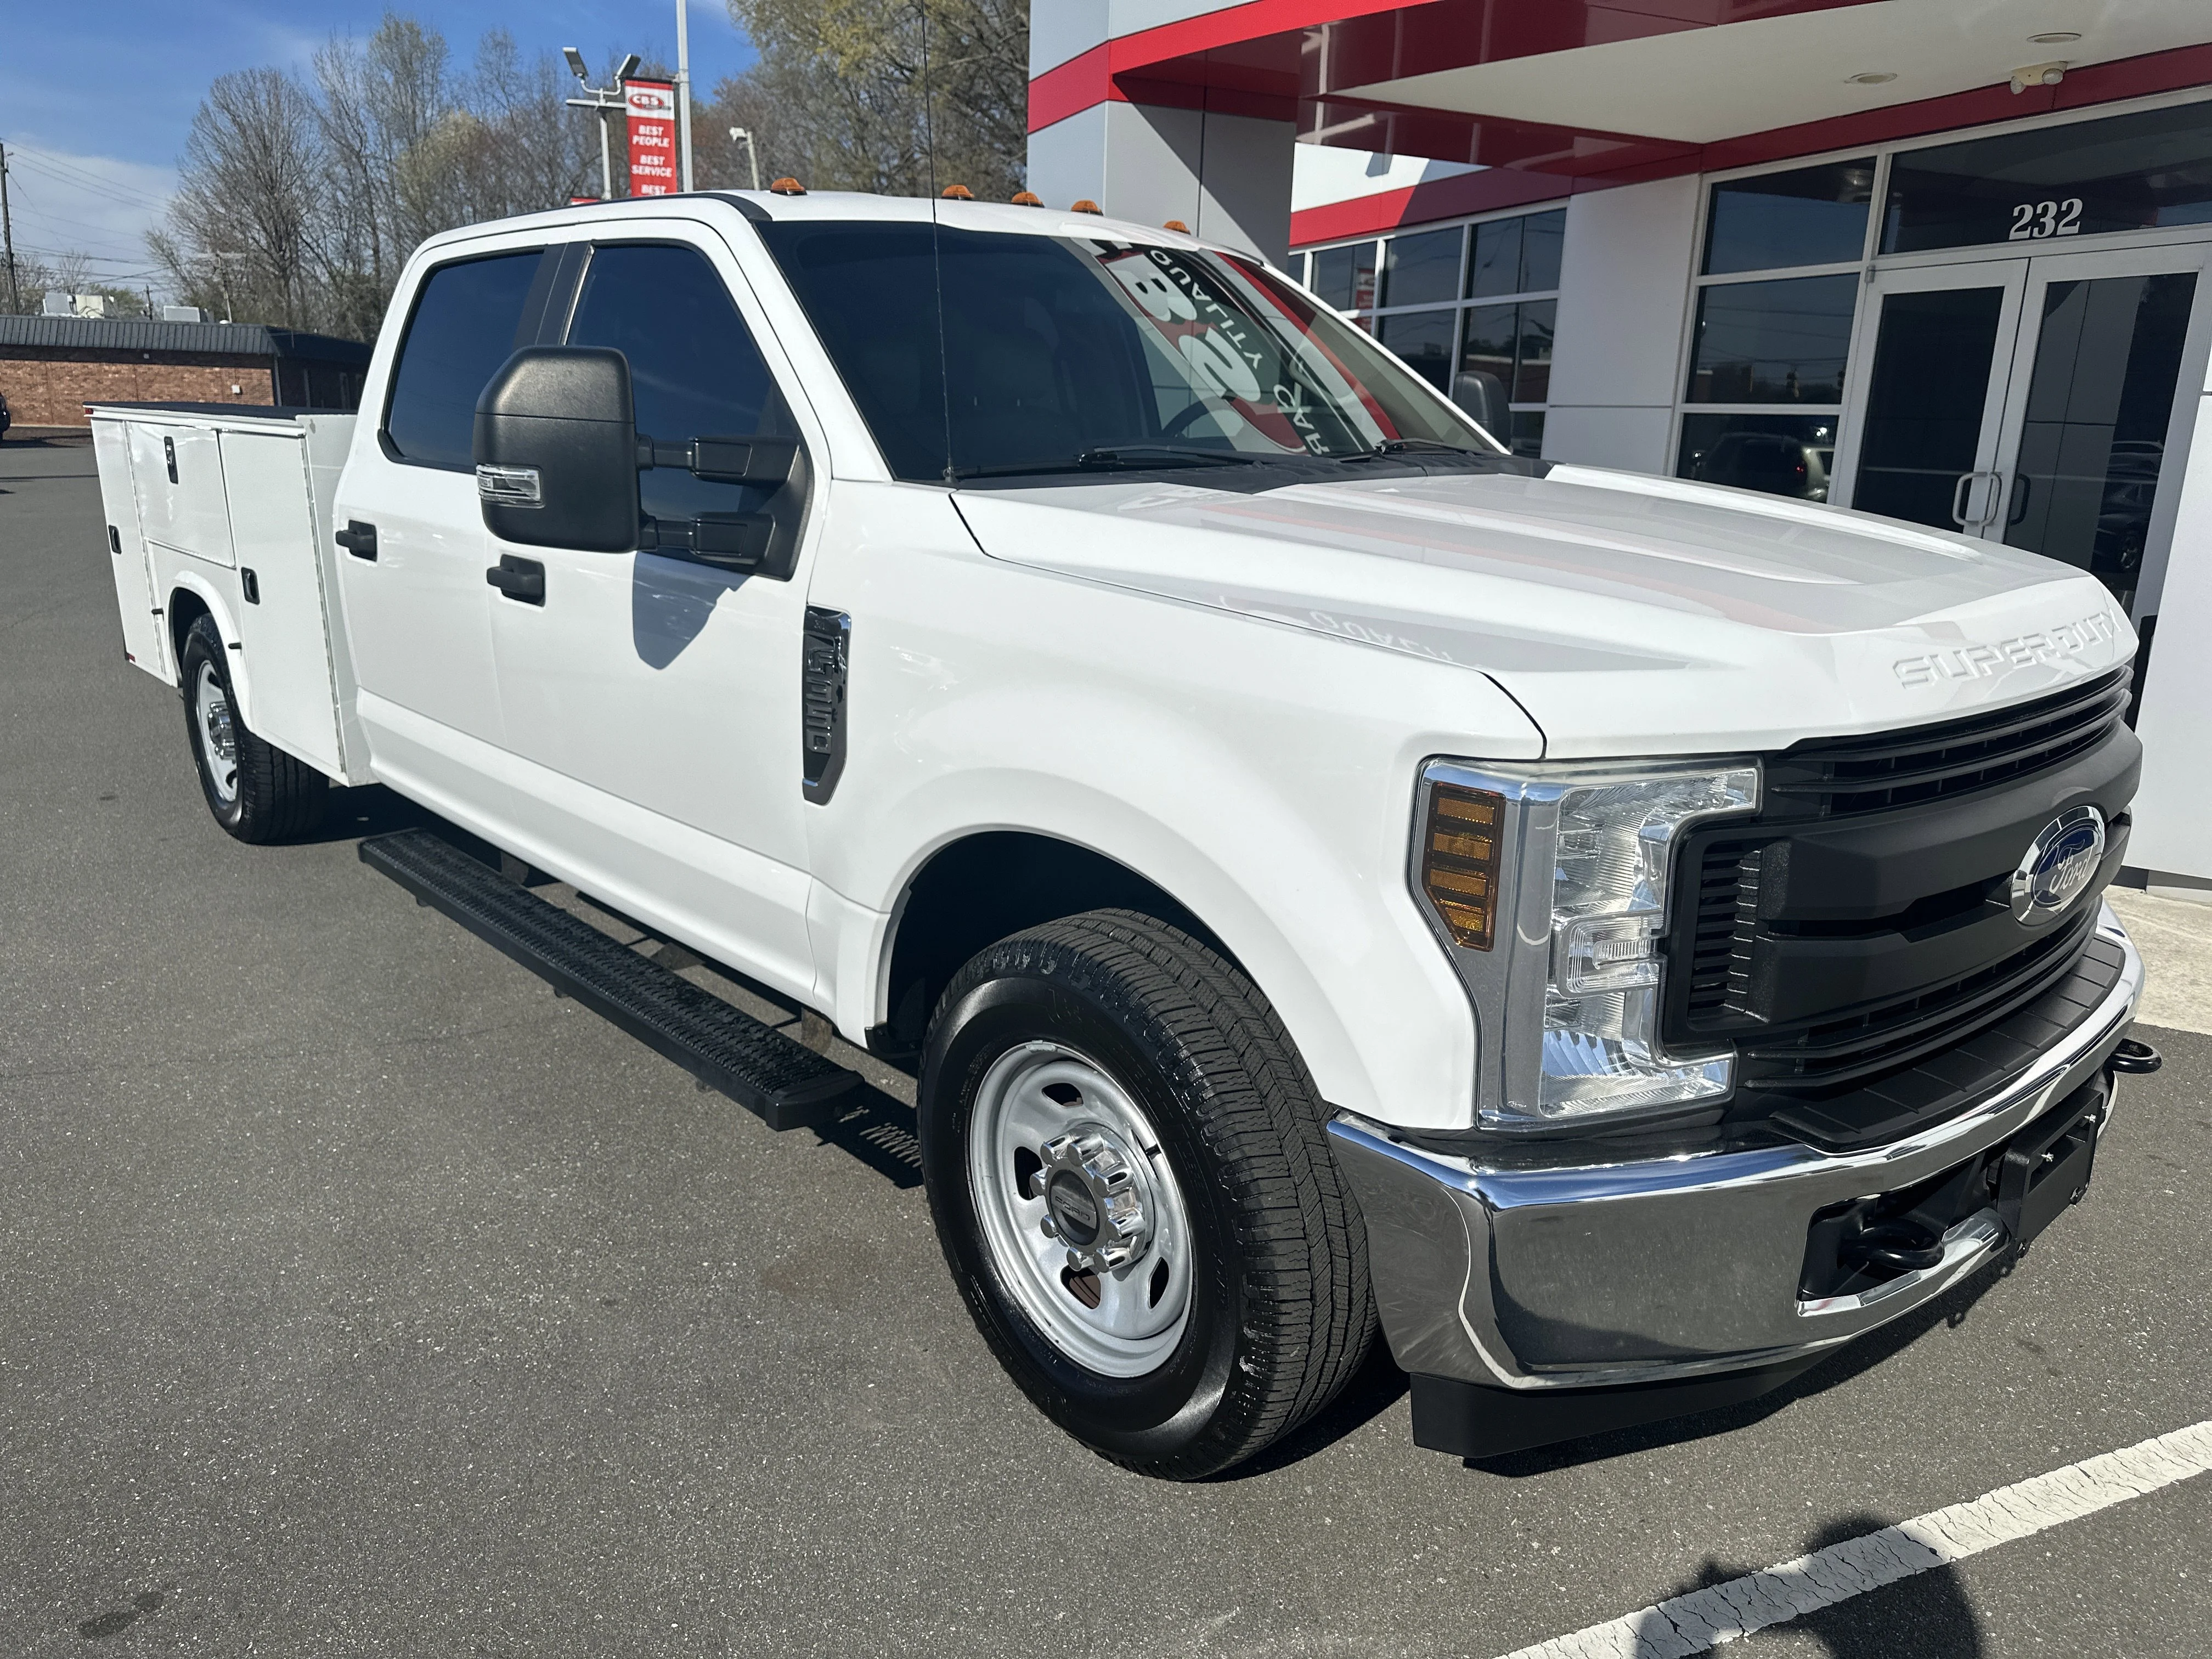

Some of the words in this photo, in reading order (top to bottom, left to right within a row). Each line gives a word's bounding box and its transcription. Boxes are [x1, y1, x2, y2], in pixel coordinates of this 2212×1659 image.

[632, 95, 659, 106] CBS
[638, 124, 664, 137] BEST
[631, 134, 670, 149] PEOPLE
[639, 154, 665, 167] BEST
[631, 164, 673, 179] SERVICE
[640, 184, 667, 196] BEST
[2008, 198, 2084, 240] 232
[1892, 631, 2062, 690] SUPER
[2051, 607, 2123, 655] DUTY
[2048, 838, 2094, 895] Ford
[1054, 1195, 1091, 1221] FORD
